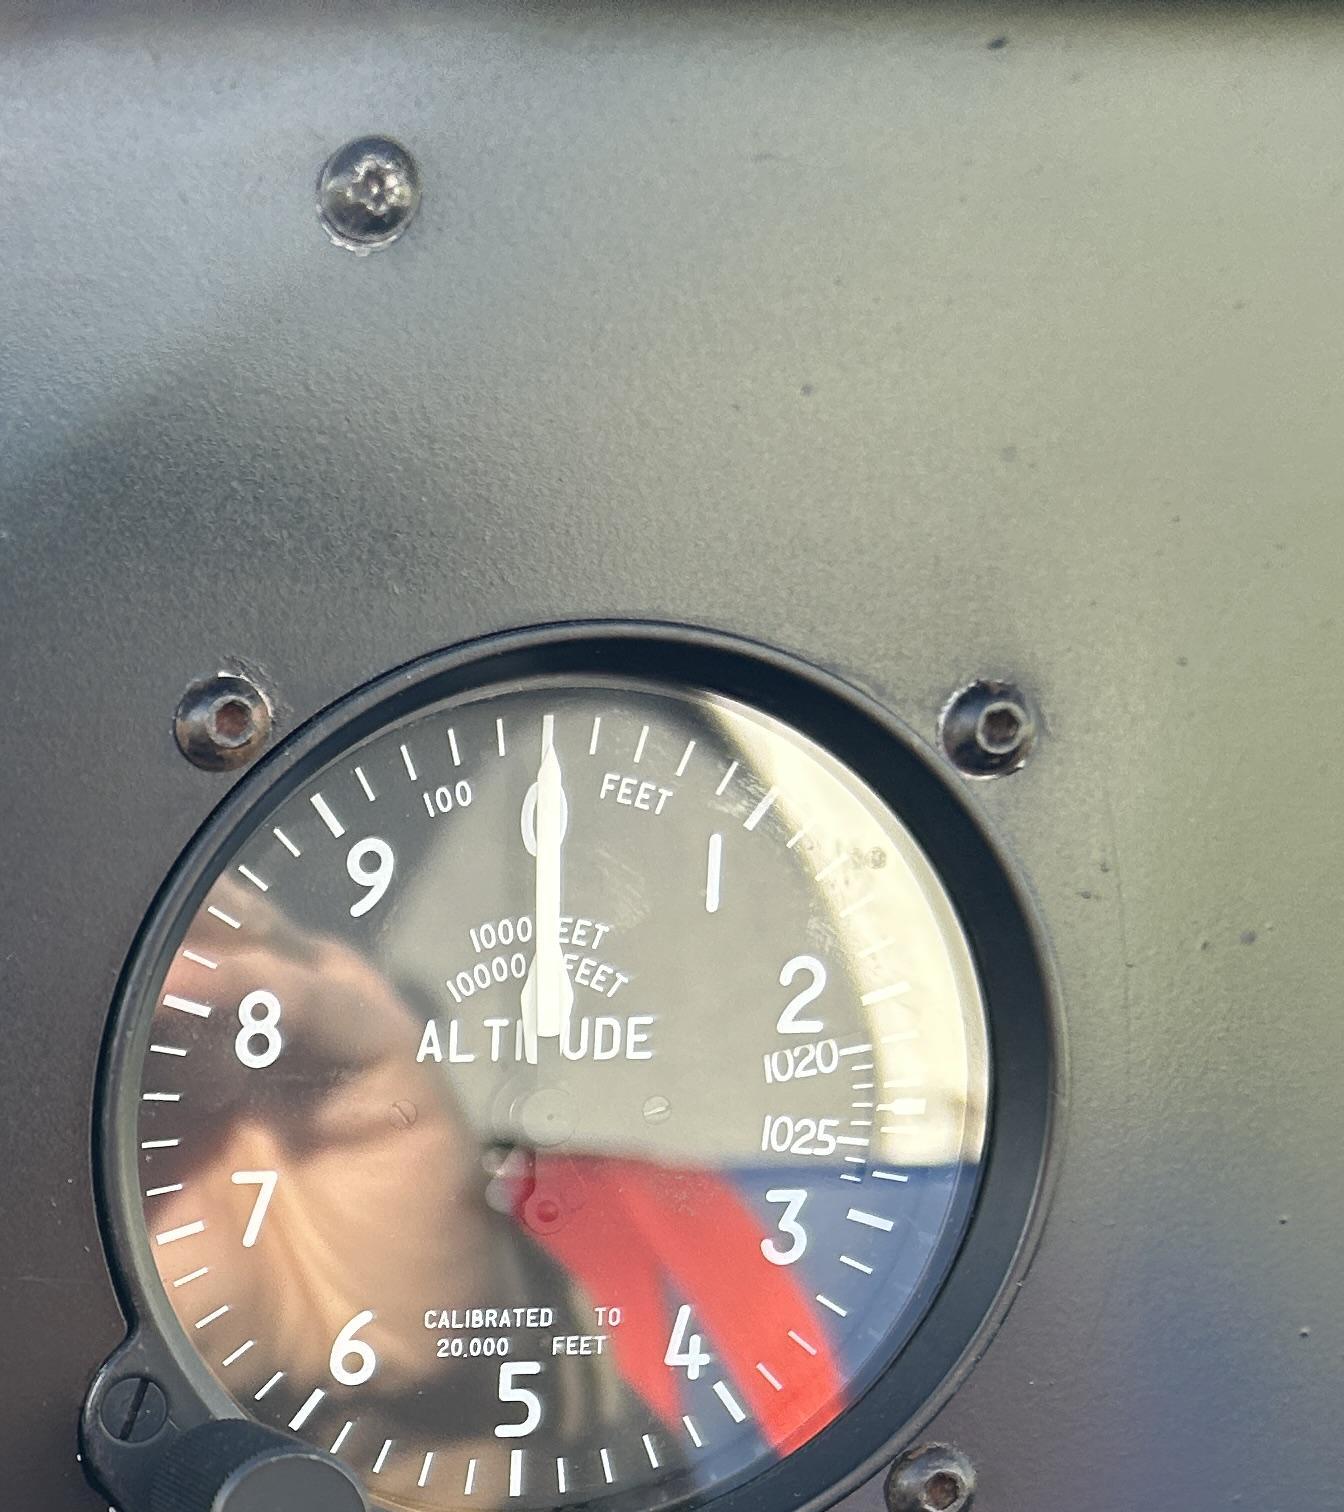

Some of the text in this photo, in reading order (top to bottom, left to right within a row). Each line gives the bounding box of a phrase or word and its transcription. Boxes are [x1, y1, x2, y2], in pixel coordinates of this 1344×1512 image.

[423, 773, 673, 818] 100 FEET
[346, 837, 394, 918] 9
[706, 834, 722, 913] 1
[469, 916, 610, 952] 1000 EET
[446, 952, 629, 1003] 10000 FEET
[777, 955, 826, 1034] 2
[235, 990, 283, 1069] 8
[416, 1016, 653, 1063] ALTIUDE
[764, 1038, 839, 1083] 1020
[762, 1115, 840, 1155] 1025
[230, 1171, 279, 1247] 7
[760, 1190, 808, 1266] 3
[329, 1311, 377, 1386] 6
[424, 1307, 622, 1329] CALIBRATED TO
[552, 1335, 607, 1356] FEET
[664, 1305, 710, 1379] 4
[494, 1360, 541, 1439] 5
